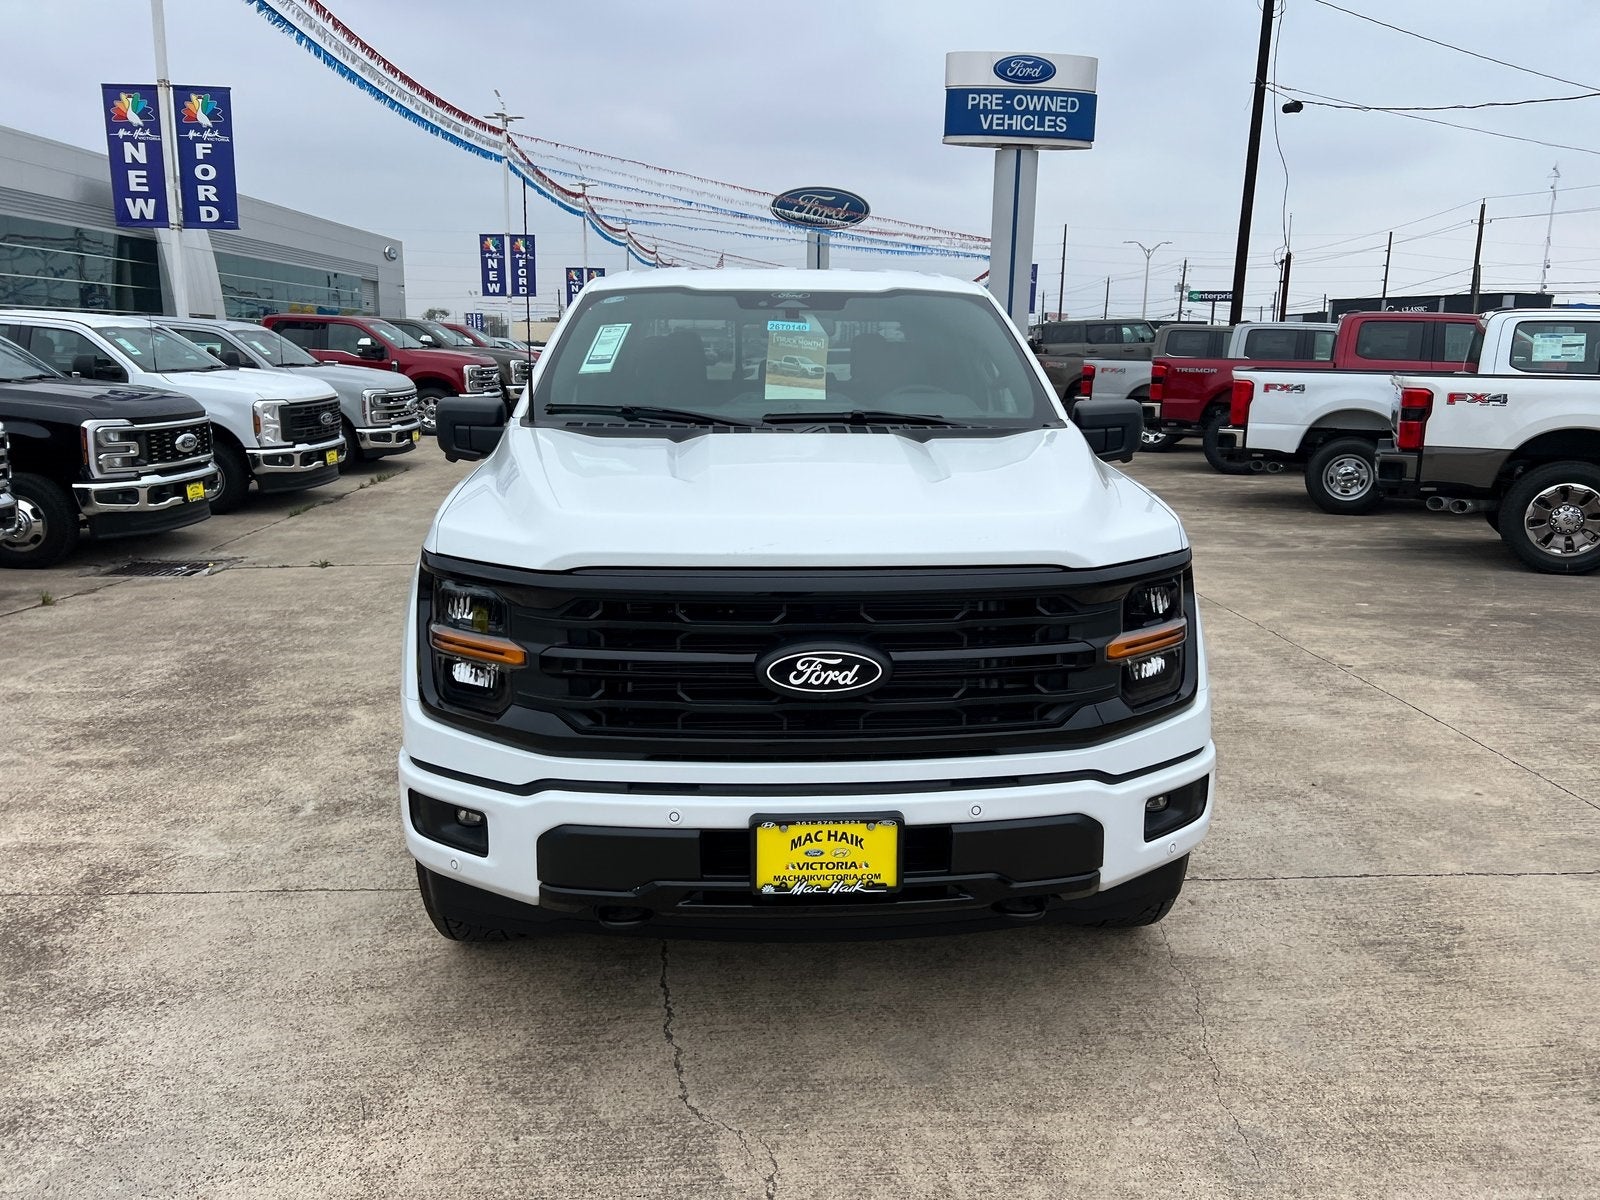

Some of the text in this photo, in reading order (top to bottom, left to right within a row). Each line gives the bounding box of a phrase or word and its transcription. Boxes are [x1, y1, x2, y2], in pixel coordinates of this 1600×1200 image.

[1006, 59, 1042, 78] Ford
[980, 114, 1067, 132] VEHICLES
[123, 142, 155, 219] NEW
[194, 143, 220, 222] FORD
[793, 194, 850, 220] Ford
[487, 259, 500, 293] NEW
[518, 260, 528, 294] FORD
[1263, 384, 1305, 392] FX4
[1446, 393, 1508, 405] FX4
[789, 657, 860, 685] Ford
[790, 830, 864, 850] MAC HAIK
[796, 861, 858, 871] VICTORIA
[773, 873, 881, 882] MACHAIKVICTORIA.COM
[785, 880, 872, 895] Mac Haik
